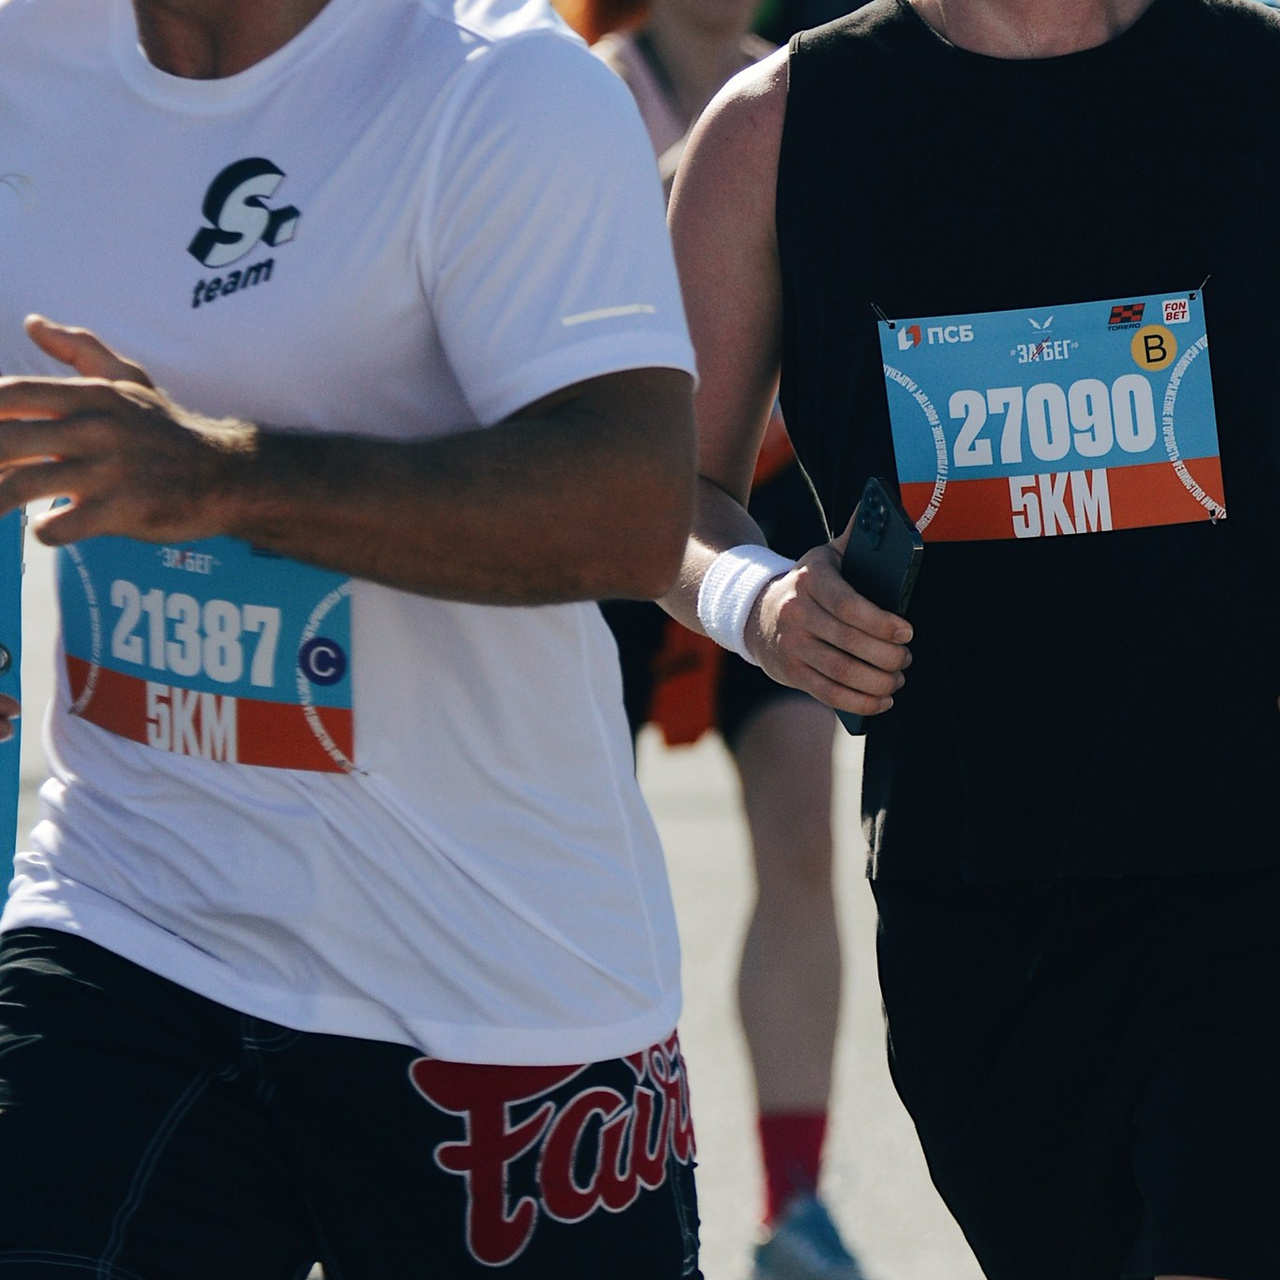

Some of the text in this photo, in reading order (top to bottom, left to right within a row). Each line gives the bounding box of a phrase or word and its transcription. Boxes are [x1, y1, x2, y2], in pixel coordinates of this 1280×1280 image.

[191, 257, 275, 309] team
[1164, 301, 1187, 312] FON
[1165, 311, 1188, 321] BET
[927, 324, 975, 346] ПСБ
[1107, 322, 1141, 332] TORERO
[1143, 334, 1168, 363] B
[912, 389, 941, 426] #ВОСТОРГ
[949, 373, 1157, 468] 27090
[110, 579, 281, 688] 21387
